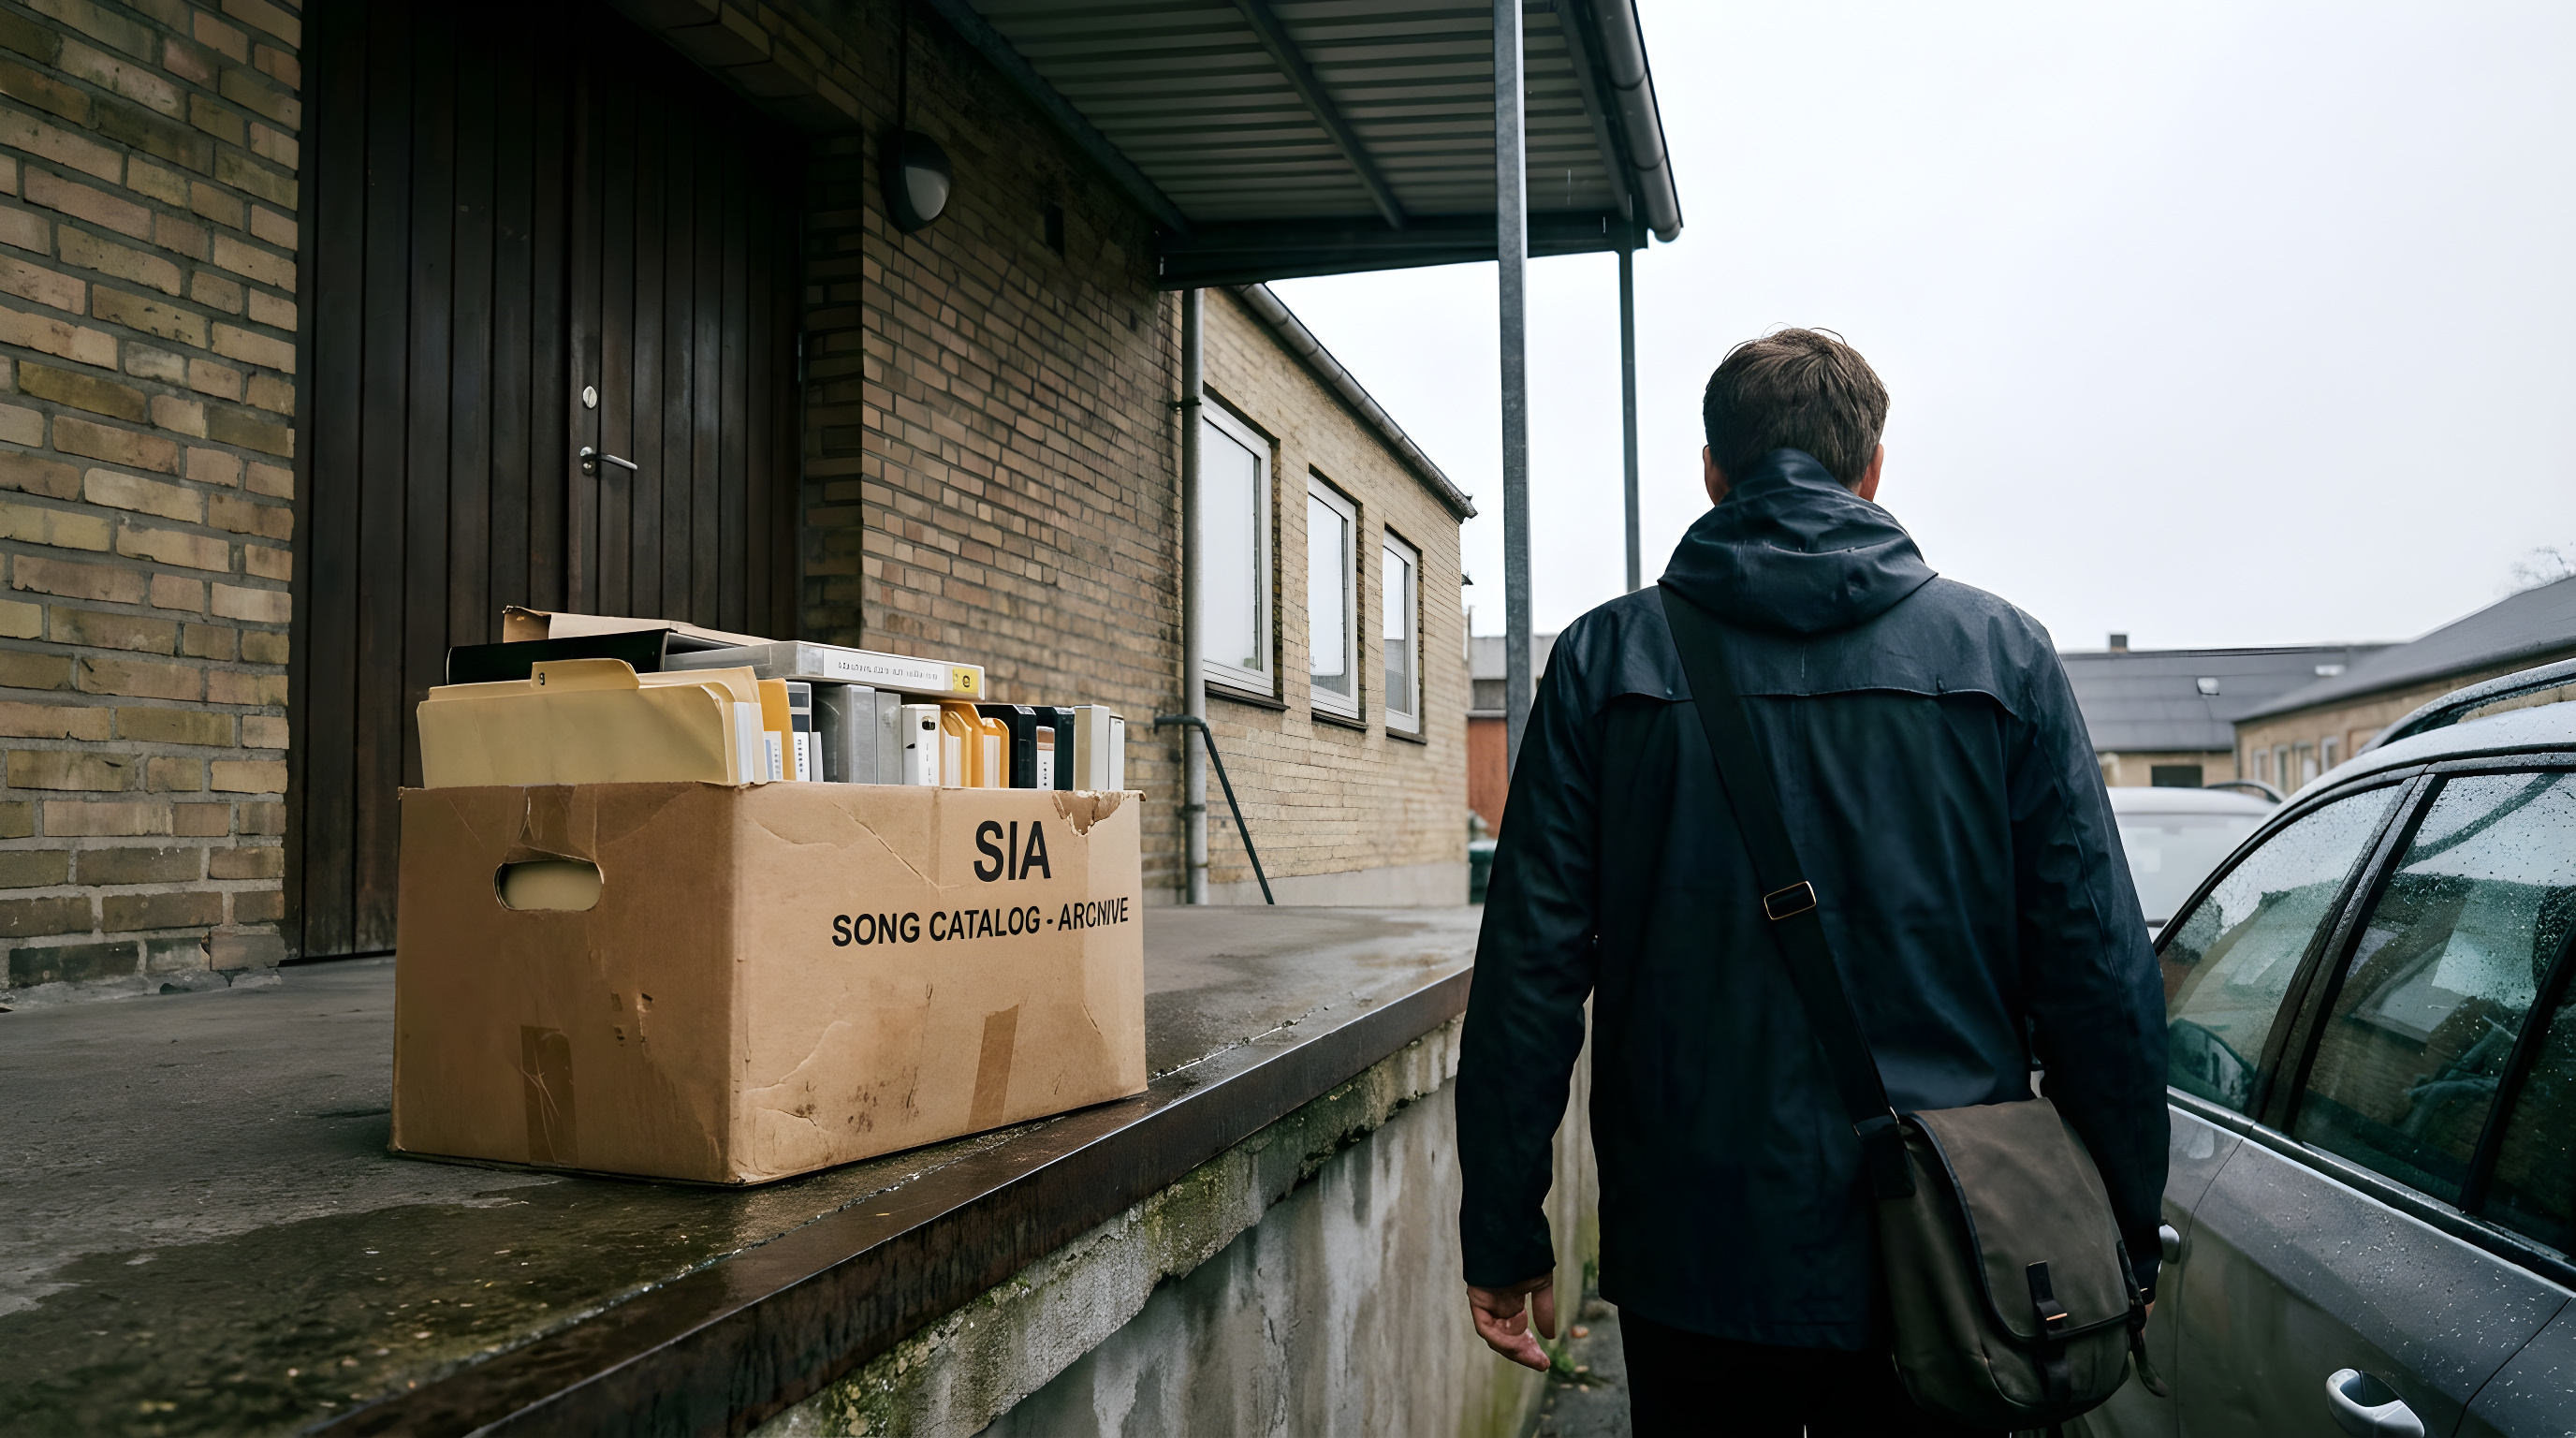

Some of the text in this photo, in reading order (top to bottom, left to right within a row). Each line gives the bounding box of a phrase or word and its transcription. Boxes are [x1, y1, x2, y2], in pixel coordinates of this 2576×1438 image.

[973, 820, 1052, 883] SIA
[831, 912, 920, 947] SONG
[929, 905, 1041, 942] CATALOG
